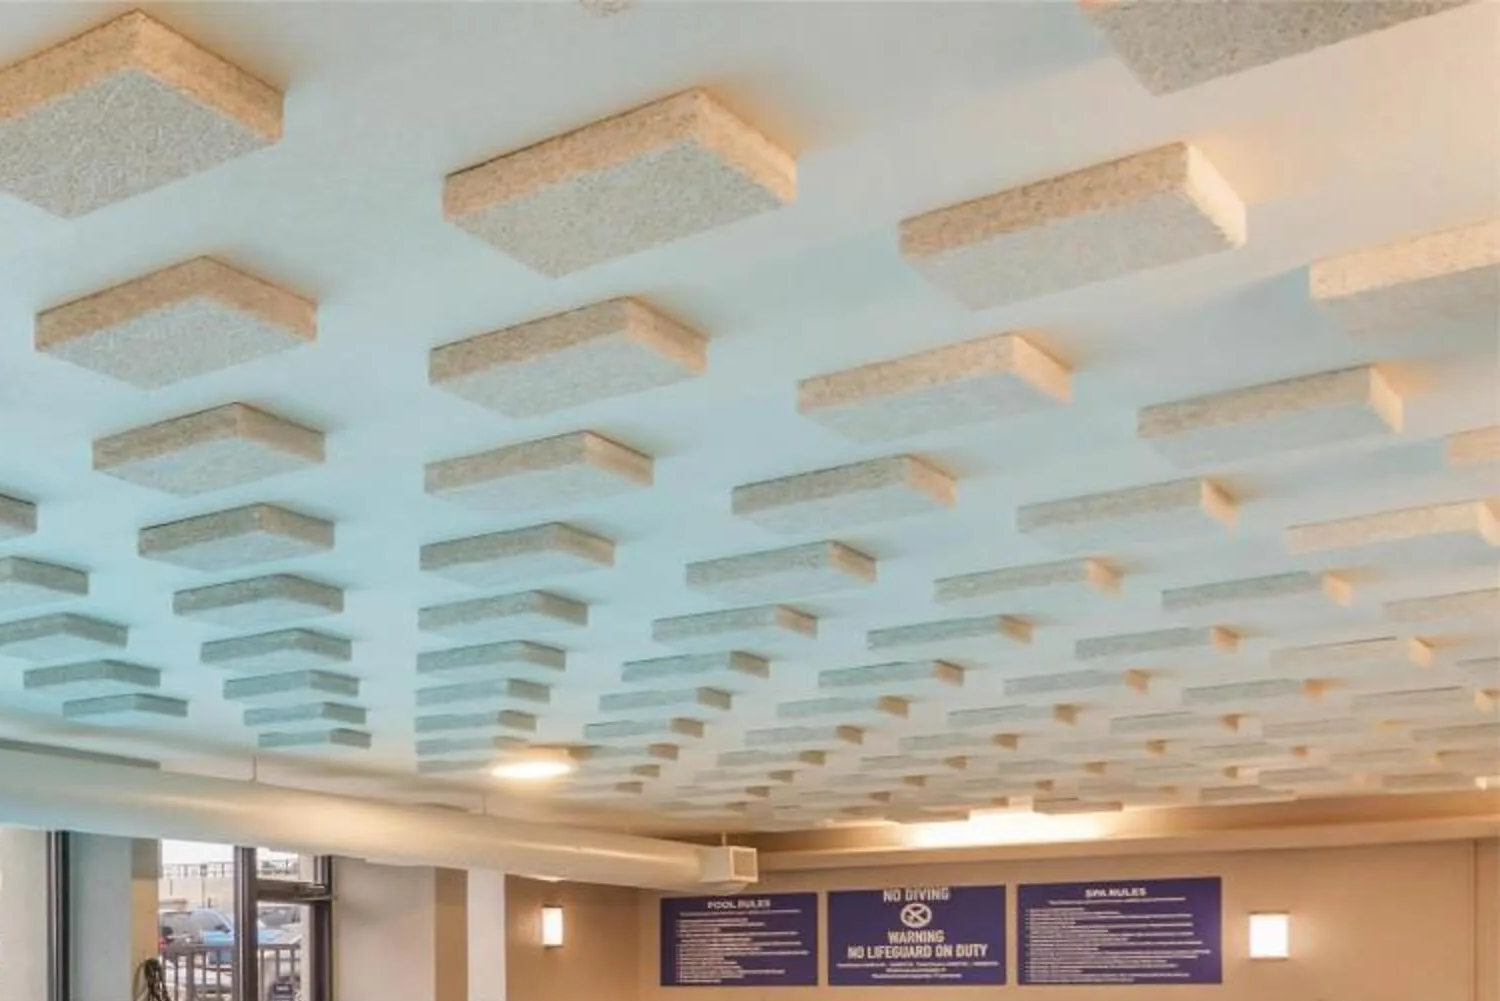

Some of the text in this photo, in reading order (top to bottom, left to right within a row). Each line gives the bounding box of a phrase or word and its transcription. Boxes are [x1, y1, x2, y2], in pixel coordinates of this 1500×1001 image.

[883, 887, 949, 902] NO DIVING
[887, 930, 945, 944] WARNING
[847, 944, 989, 959] NO LIFEGUARD ON DUTY
